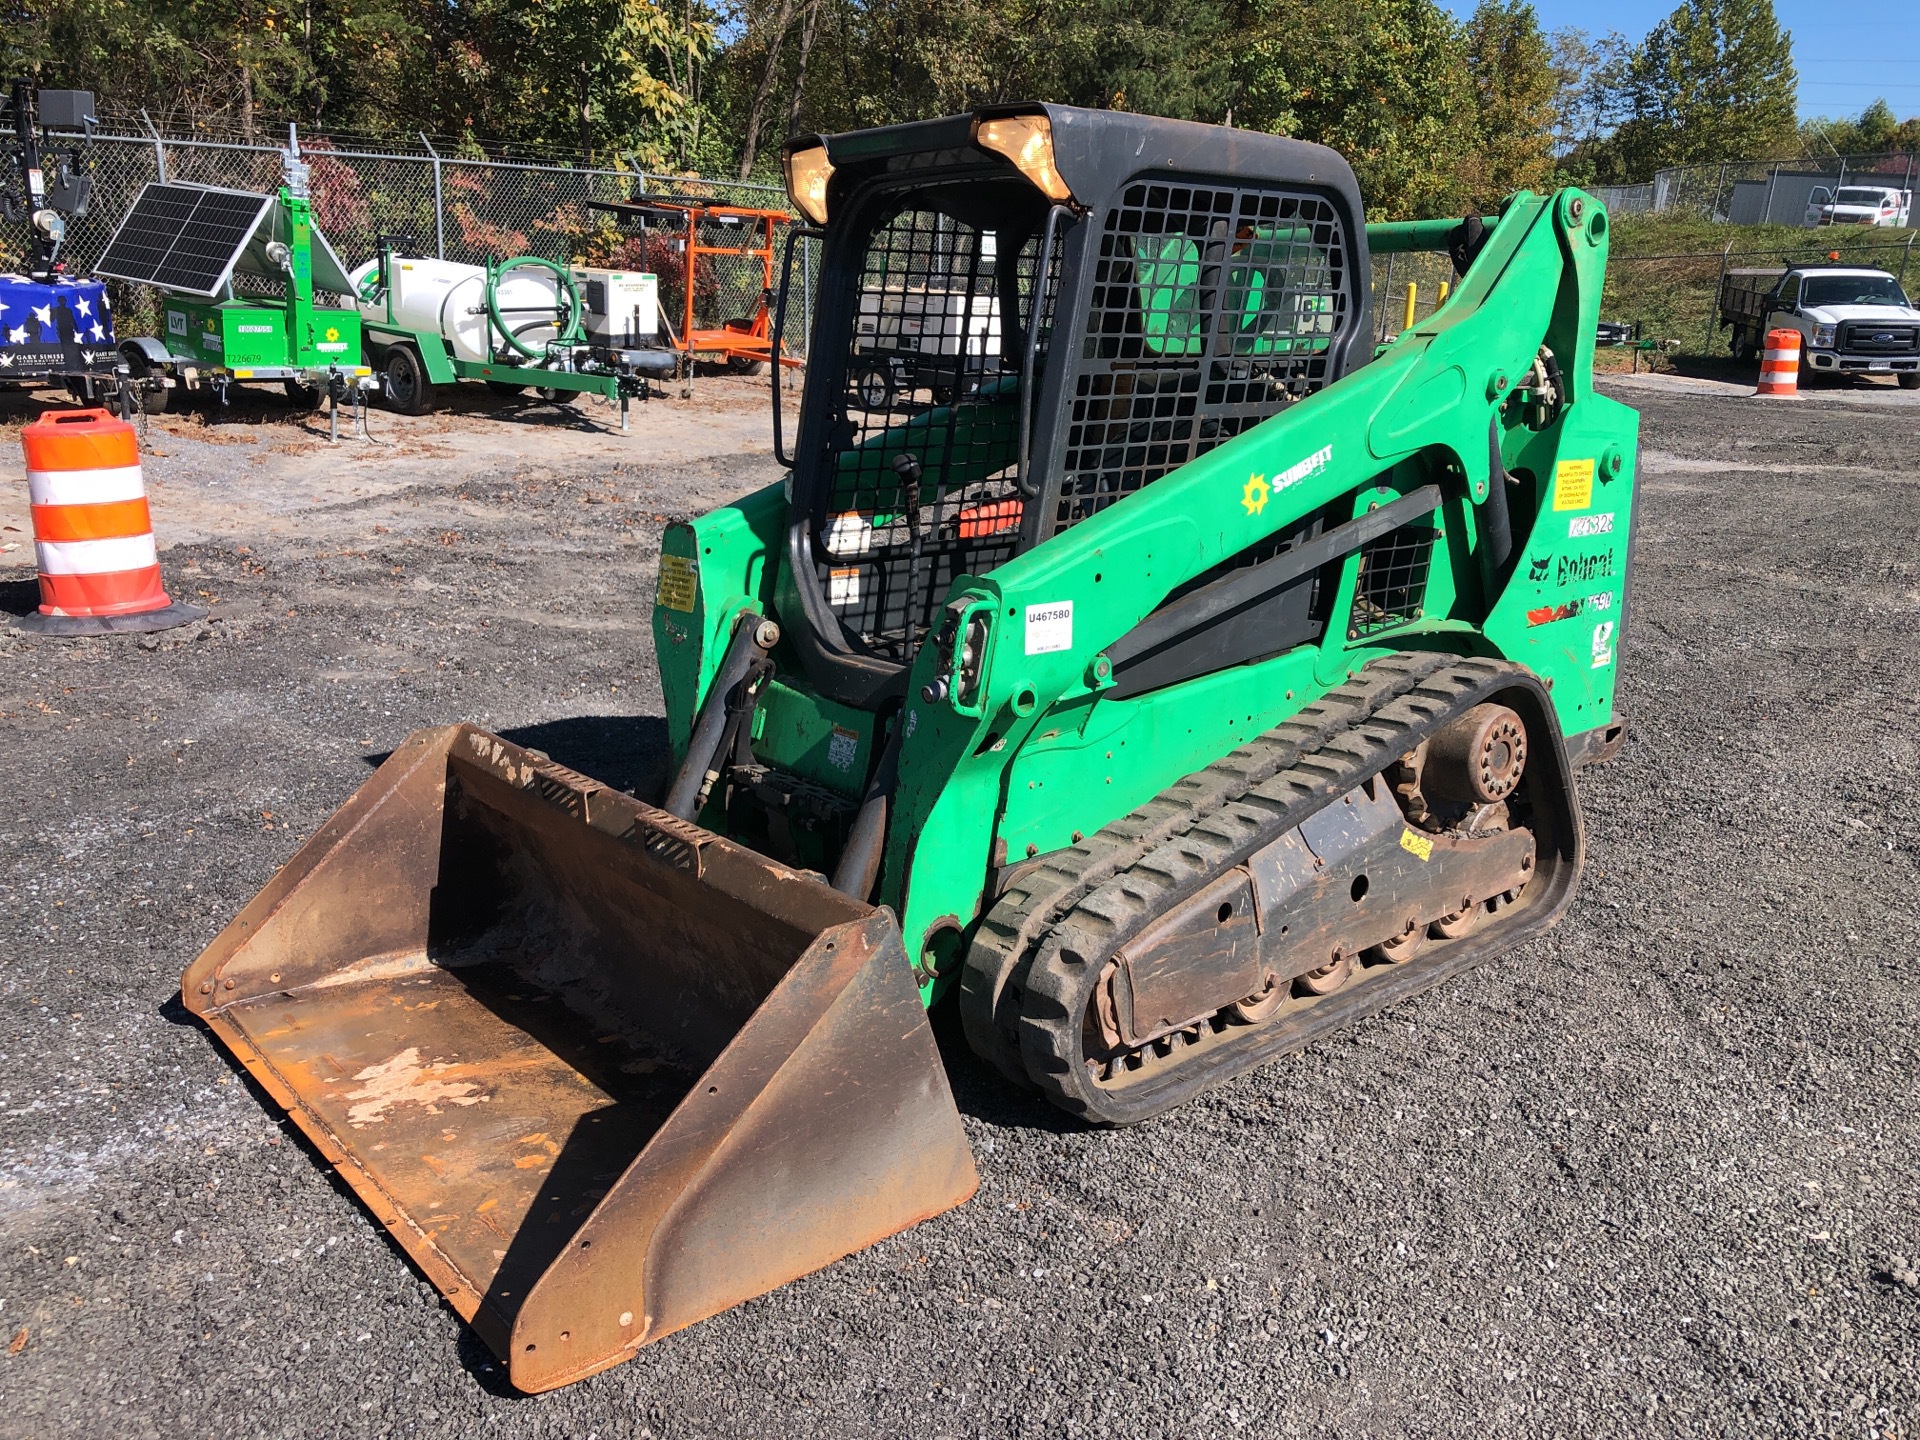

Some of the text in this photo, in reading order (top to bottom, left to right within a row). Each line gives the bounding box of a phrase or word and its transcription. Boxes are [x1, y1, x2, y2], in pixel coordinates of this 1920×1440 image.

[170, 315, 184, 331] LVT
[226, 354, 262, 363] T226679
[1271, 443, 1333, 494] SUNBELT
[1557, 547, 1613, 587] Bobcat
[1587, 590, 1614, 612] T590
[1029, 609, 1070, 623] U467580
